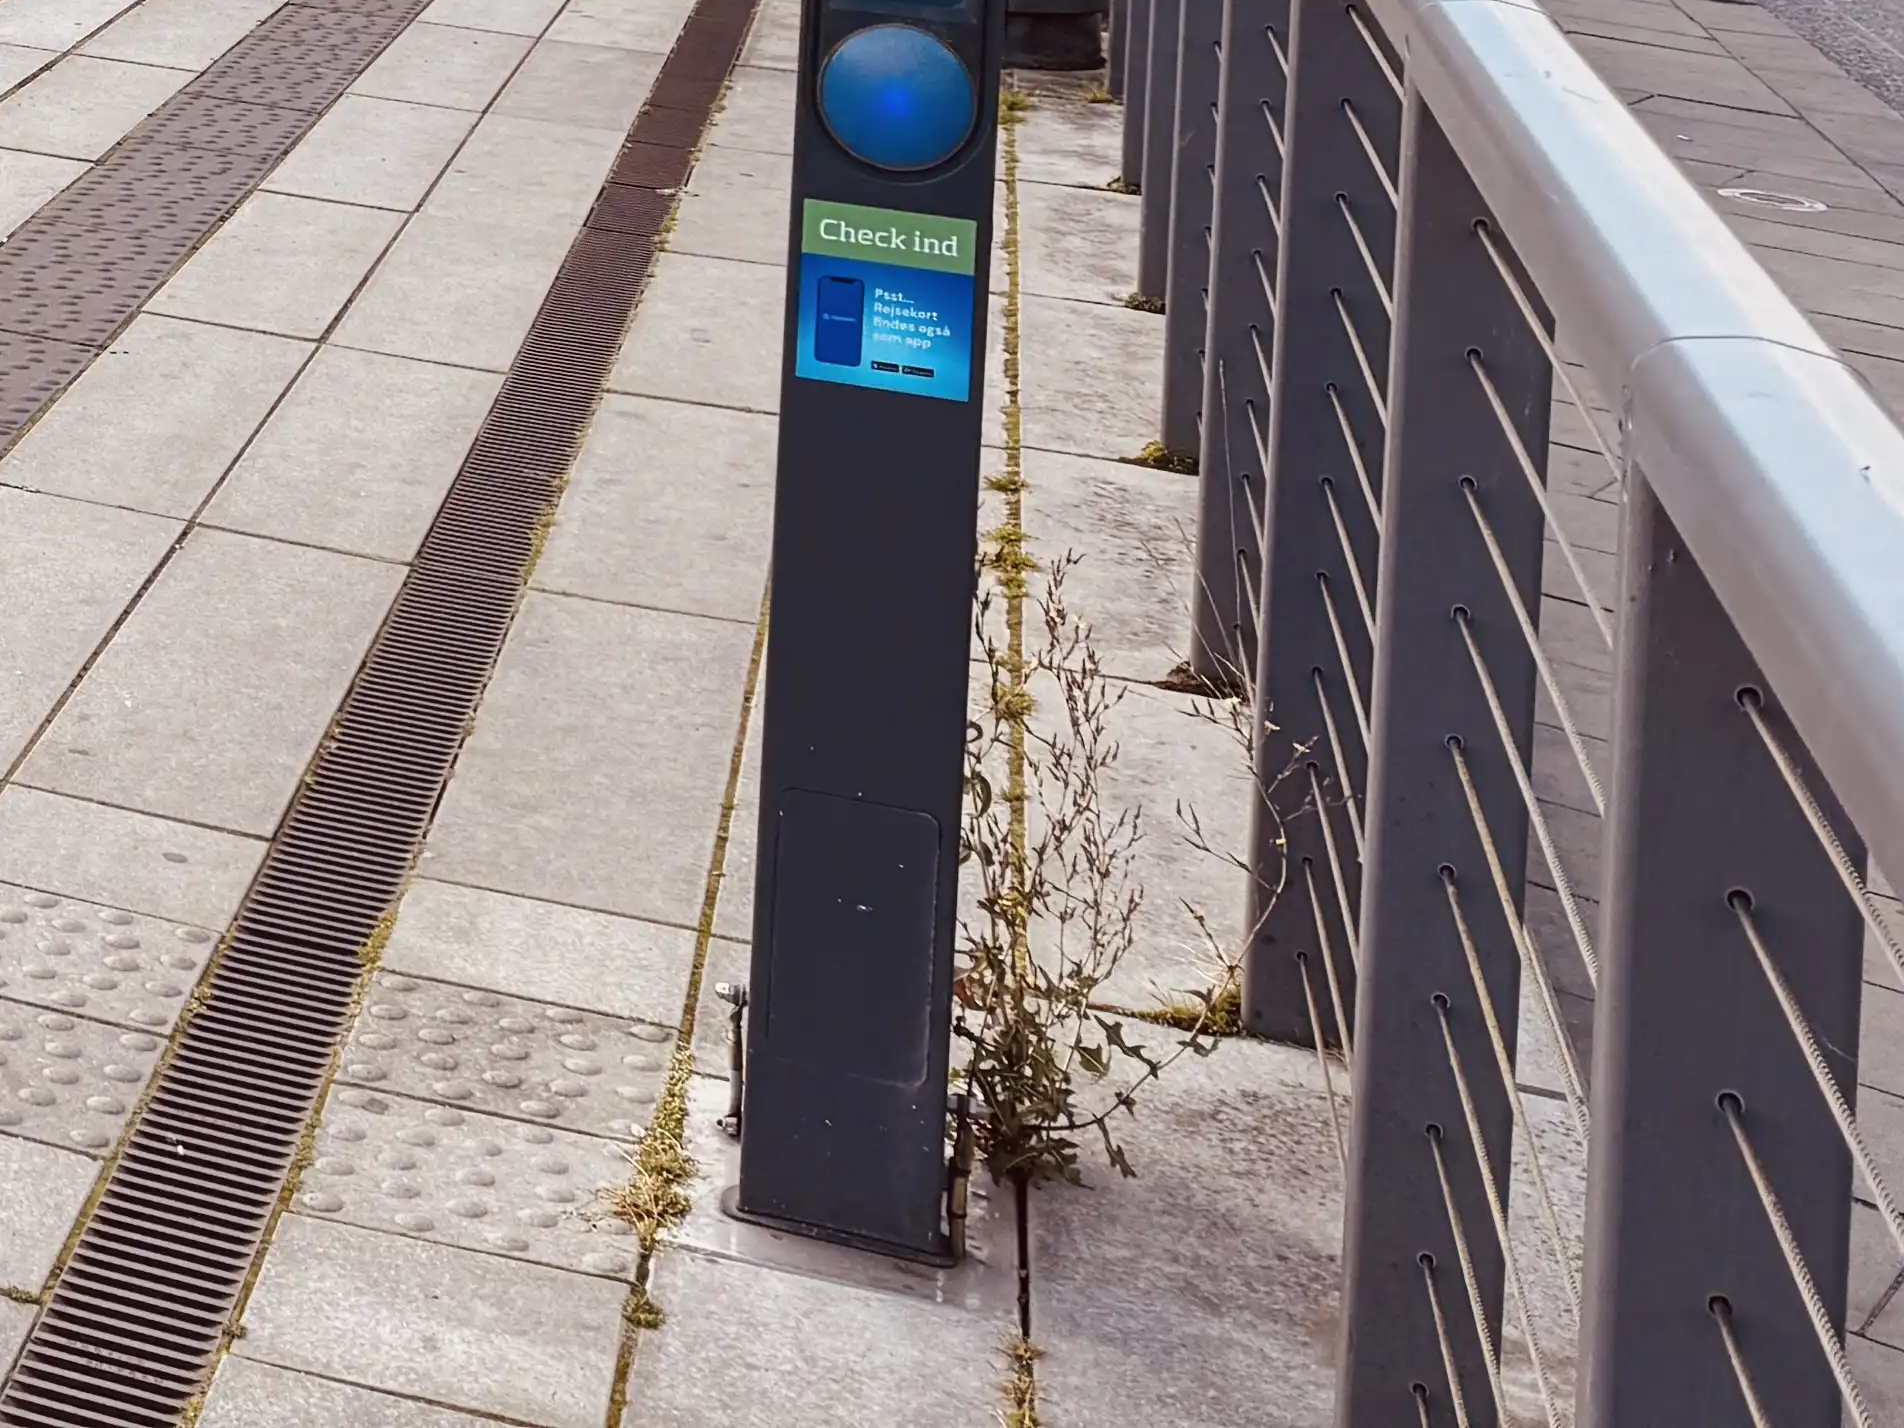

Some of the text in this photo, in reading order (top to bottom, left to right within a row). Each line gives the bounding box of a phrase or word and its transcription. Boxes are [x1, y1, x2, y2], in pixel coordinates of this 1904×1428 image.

[820, 218, 958, 257] Check ind
[874, 301, 939, 322] Rejsekort
